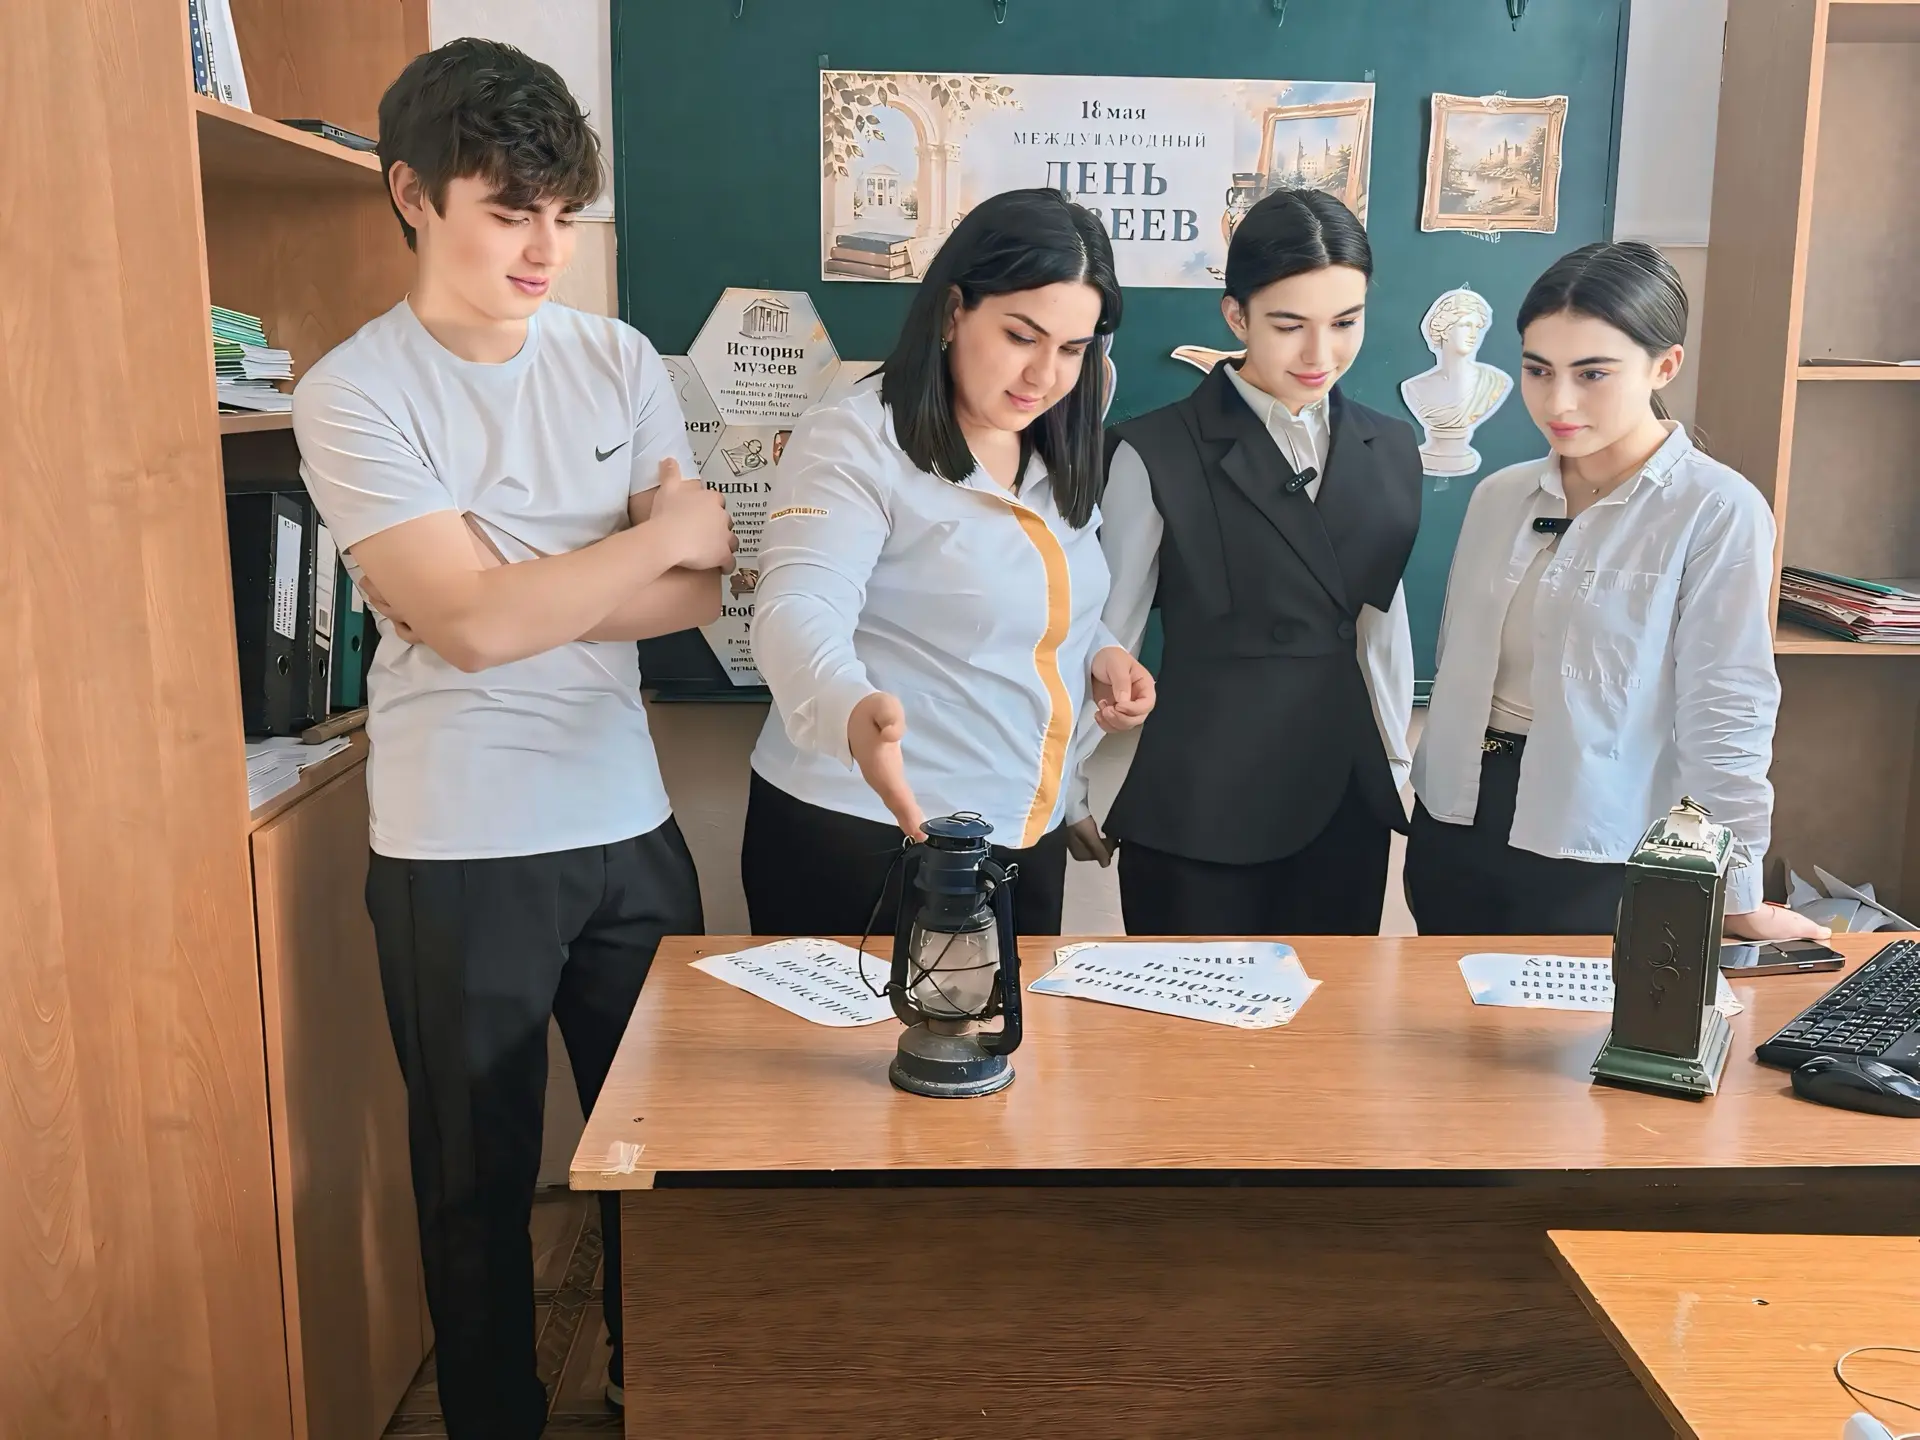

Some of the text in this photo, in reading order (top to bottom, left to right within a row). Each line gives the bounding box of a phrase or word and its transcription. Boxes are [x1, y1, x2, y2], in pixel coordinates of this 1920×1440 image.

[1082, 100, 1147, 120] 18 мая
[1014, 131, 1206, 148] МЕЖДУНАРОДНЫЙ
[1046, 161, 1168, 196] ДЕНЬ
[727, 342, 804, 360] История
[733, 361, 797, 376] музеев
